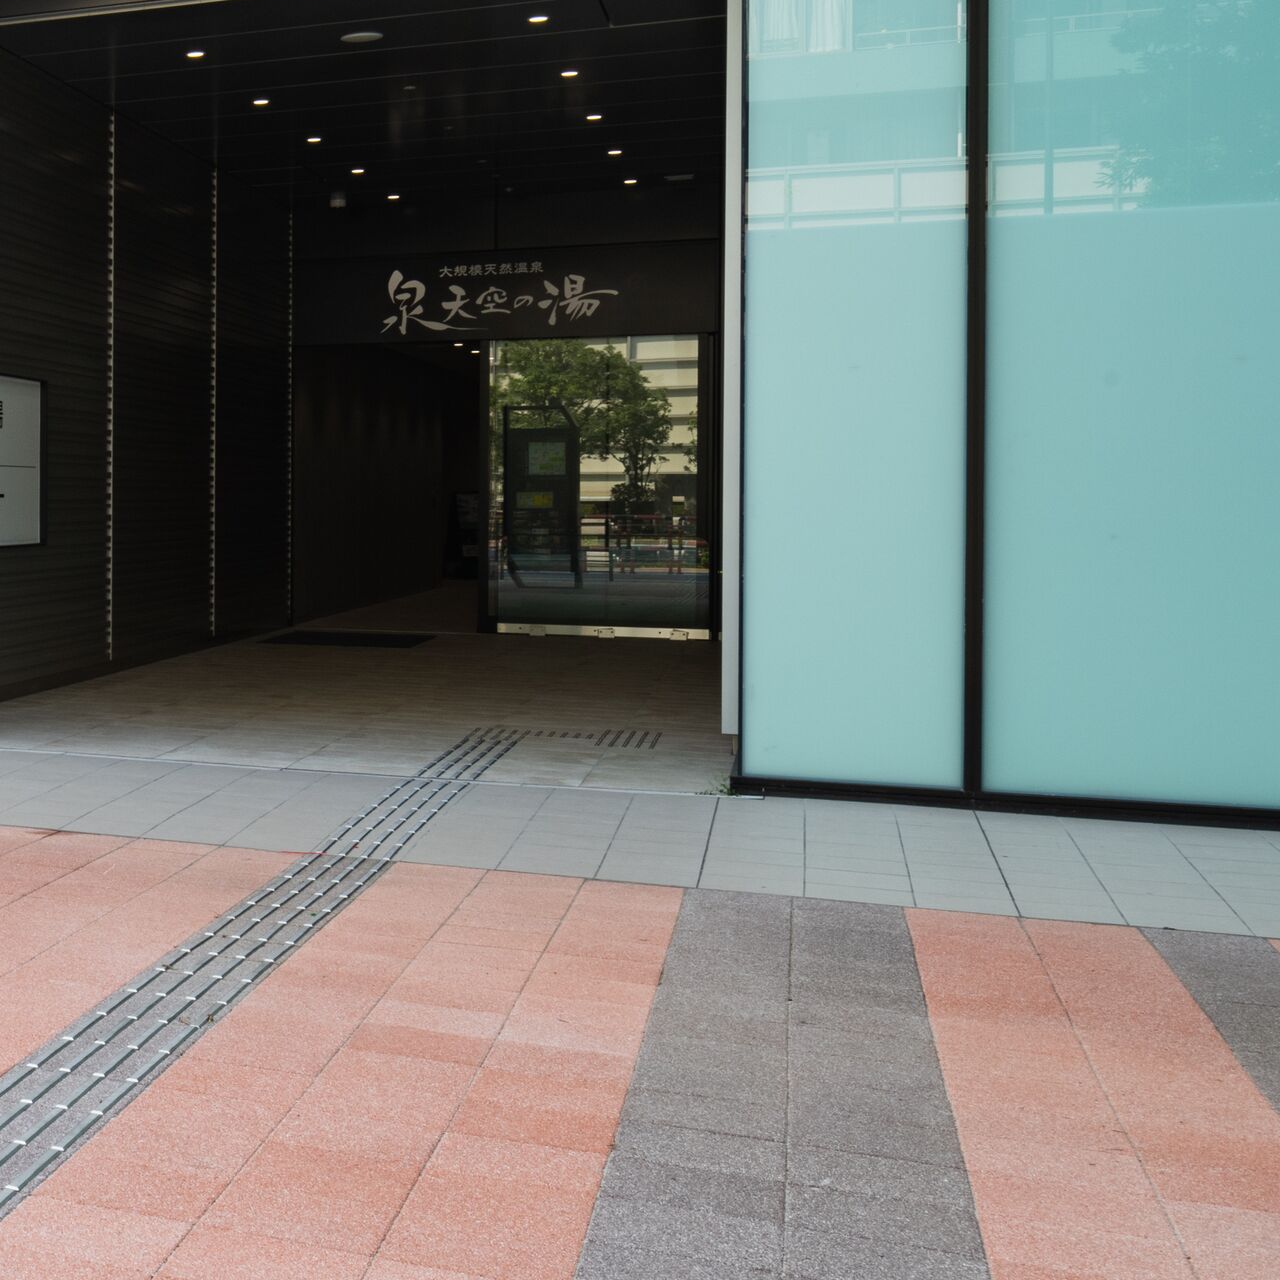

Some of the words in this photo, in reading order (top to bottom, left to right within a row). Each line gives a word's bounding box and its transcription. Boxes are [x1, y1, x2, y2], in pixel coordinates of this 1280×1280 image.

[439, 261, 544, 278] 大規模天然温泉
[380, 270, 619, 336] 泉天空の湯
